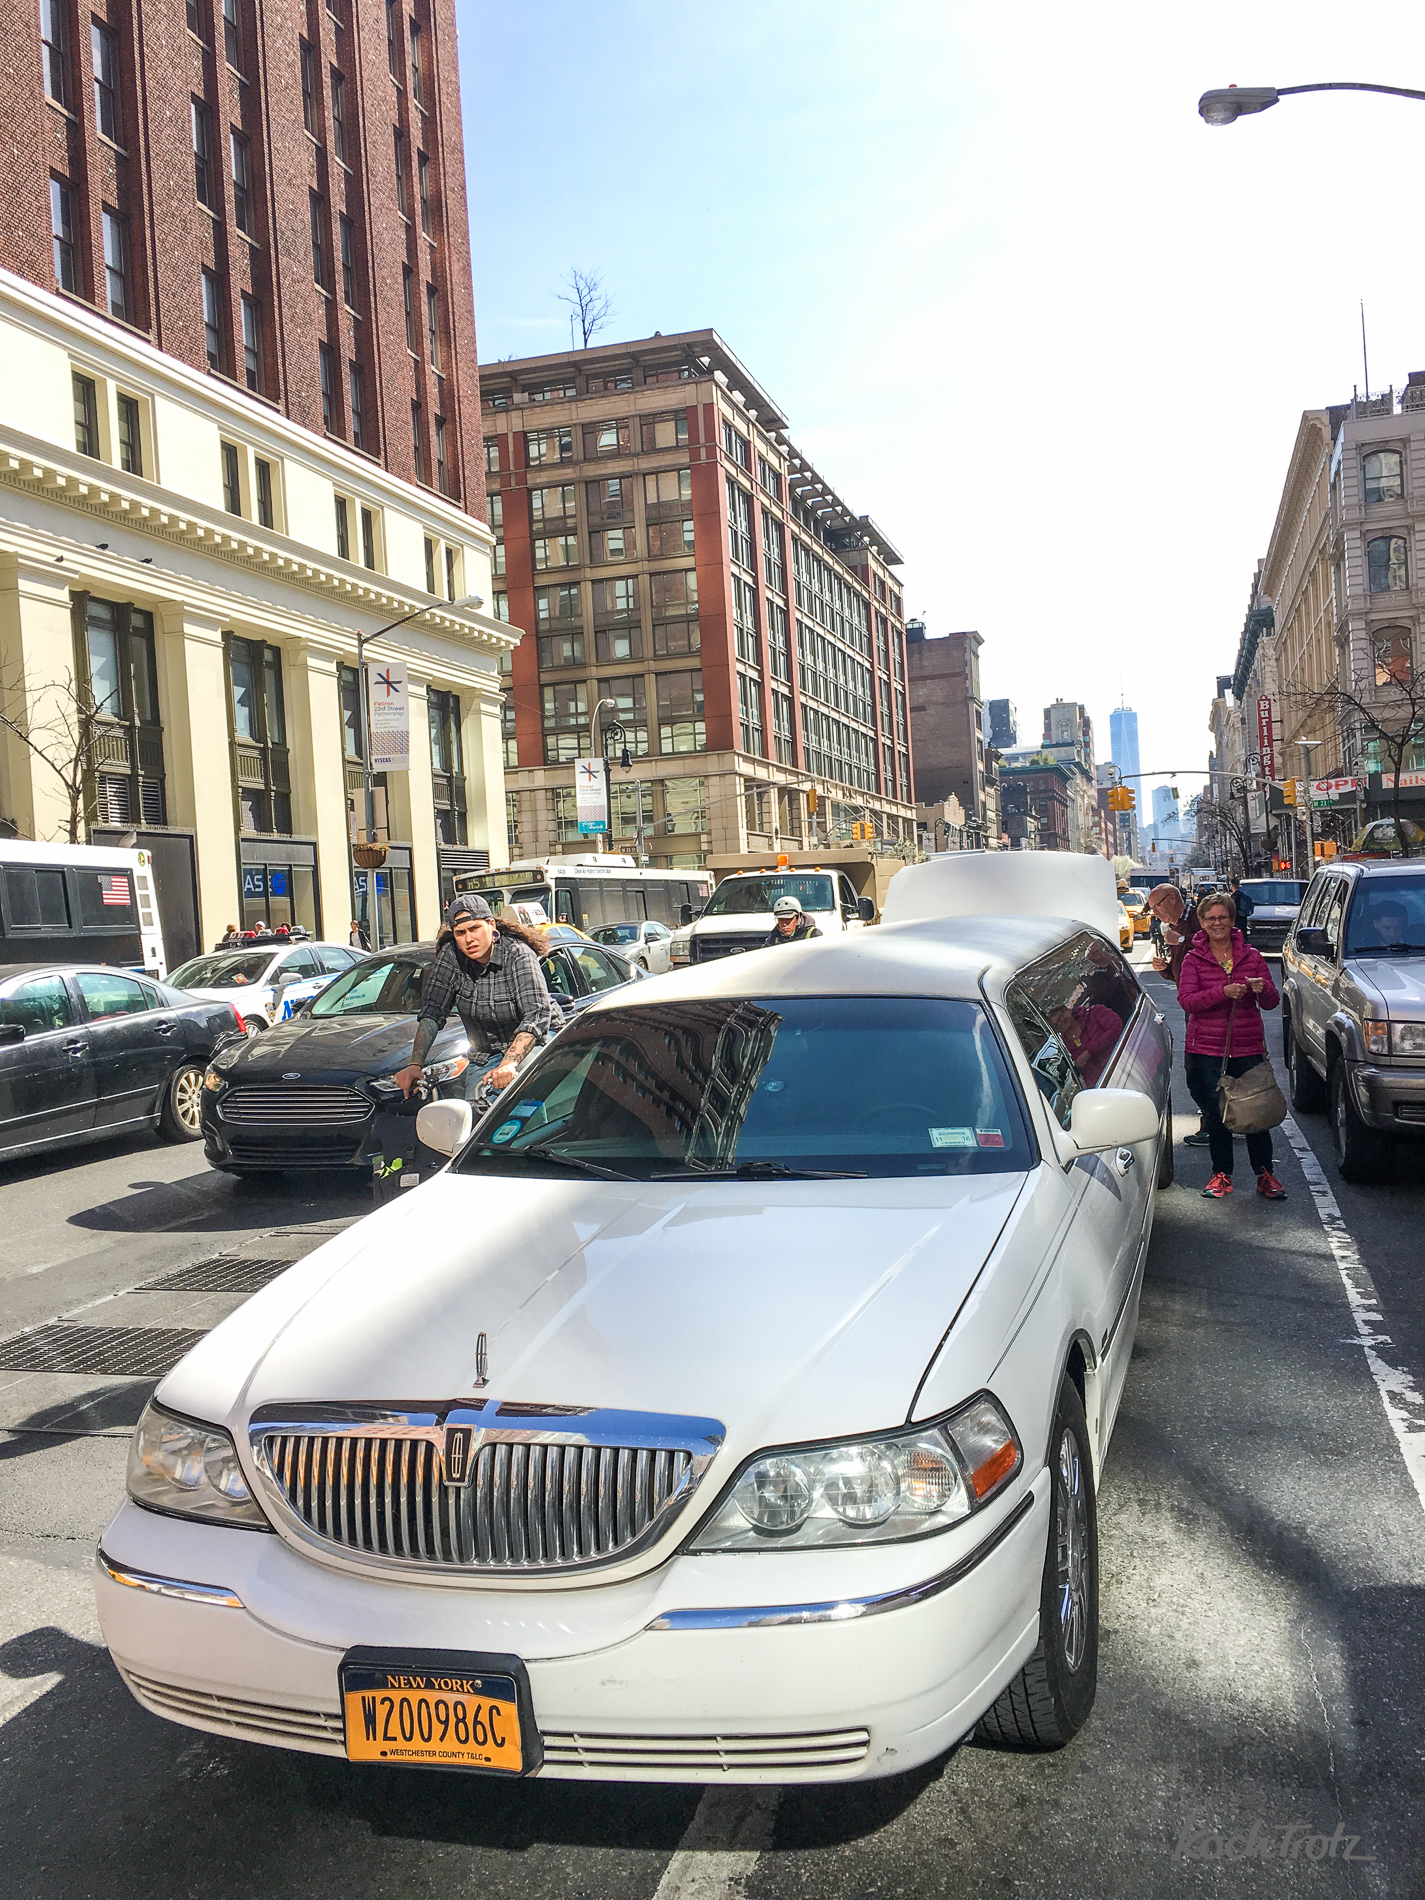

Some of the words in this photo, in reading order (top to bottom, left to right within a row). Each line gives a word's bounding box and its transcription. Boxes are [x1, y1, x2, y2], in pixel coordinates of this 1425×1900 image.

[387, 1675, 426, 1689] NEW
[430, 1677, 475, 1693] YORK
[361, 1695, 506, 1748] W200986C
[389, 1748, 437, 1758] WESTCHESTER
[438, 1750, 465, 1759] COUNTY
[467, 1752, 483, 1760] T&LC
